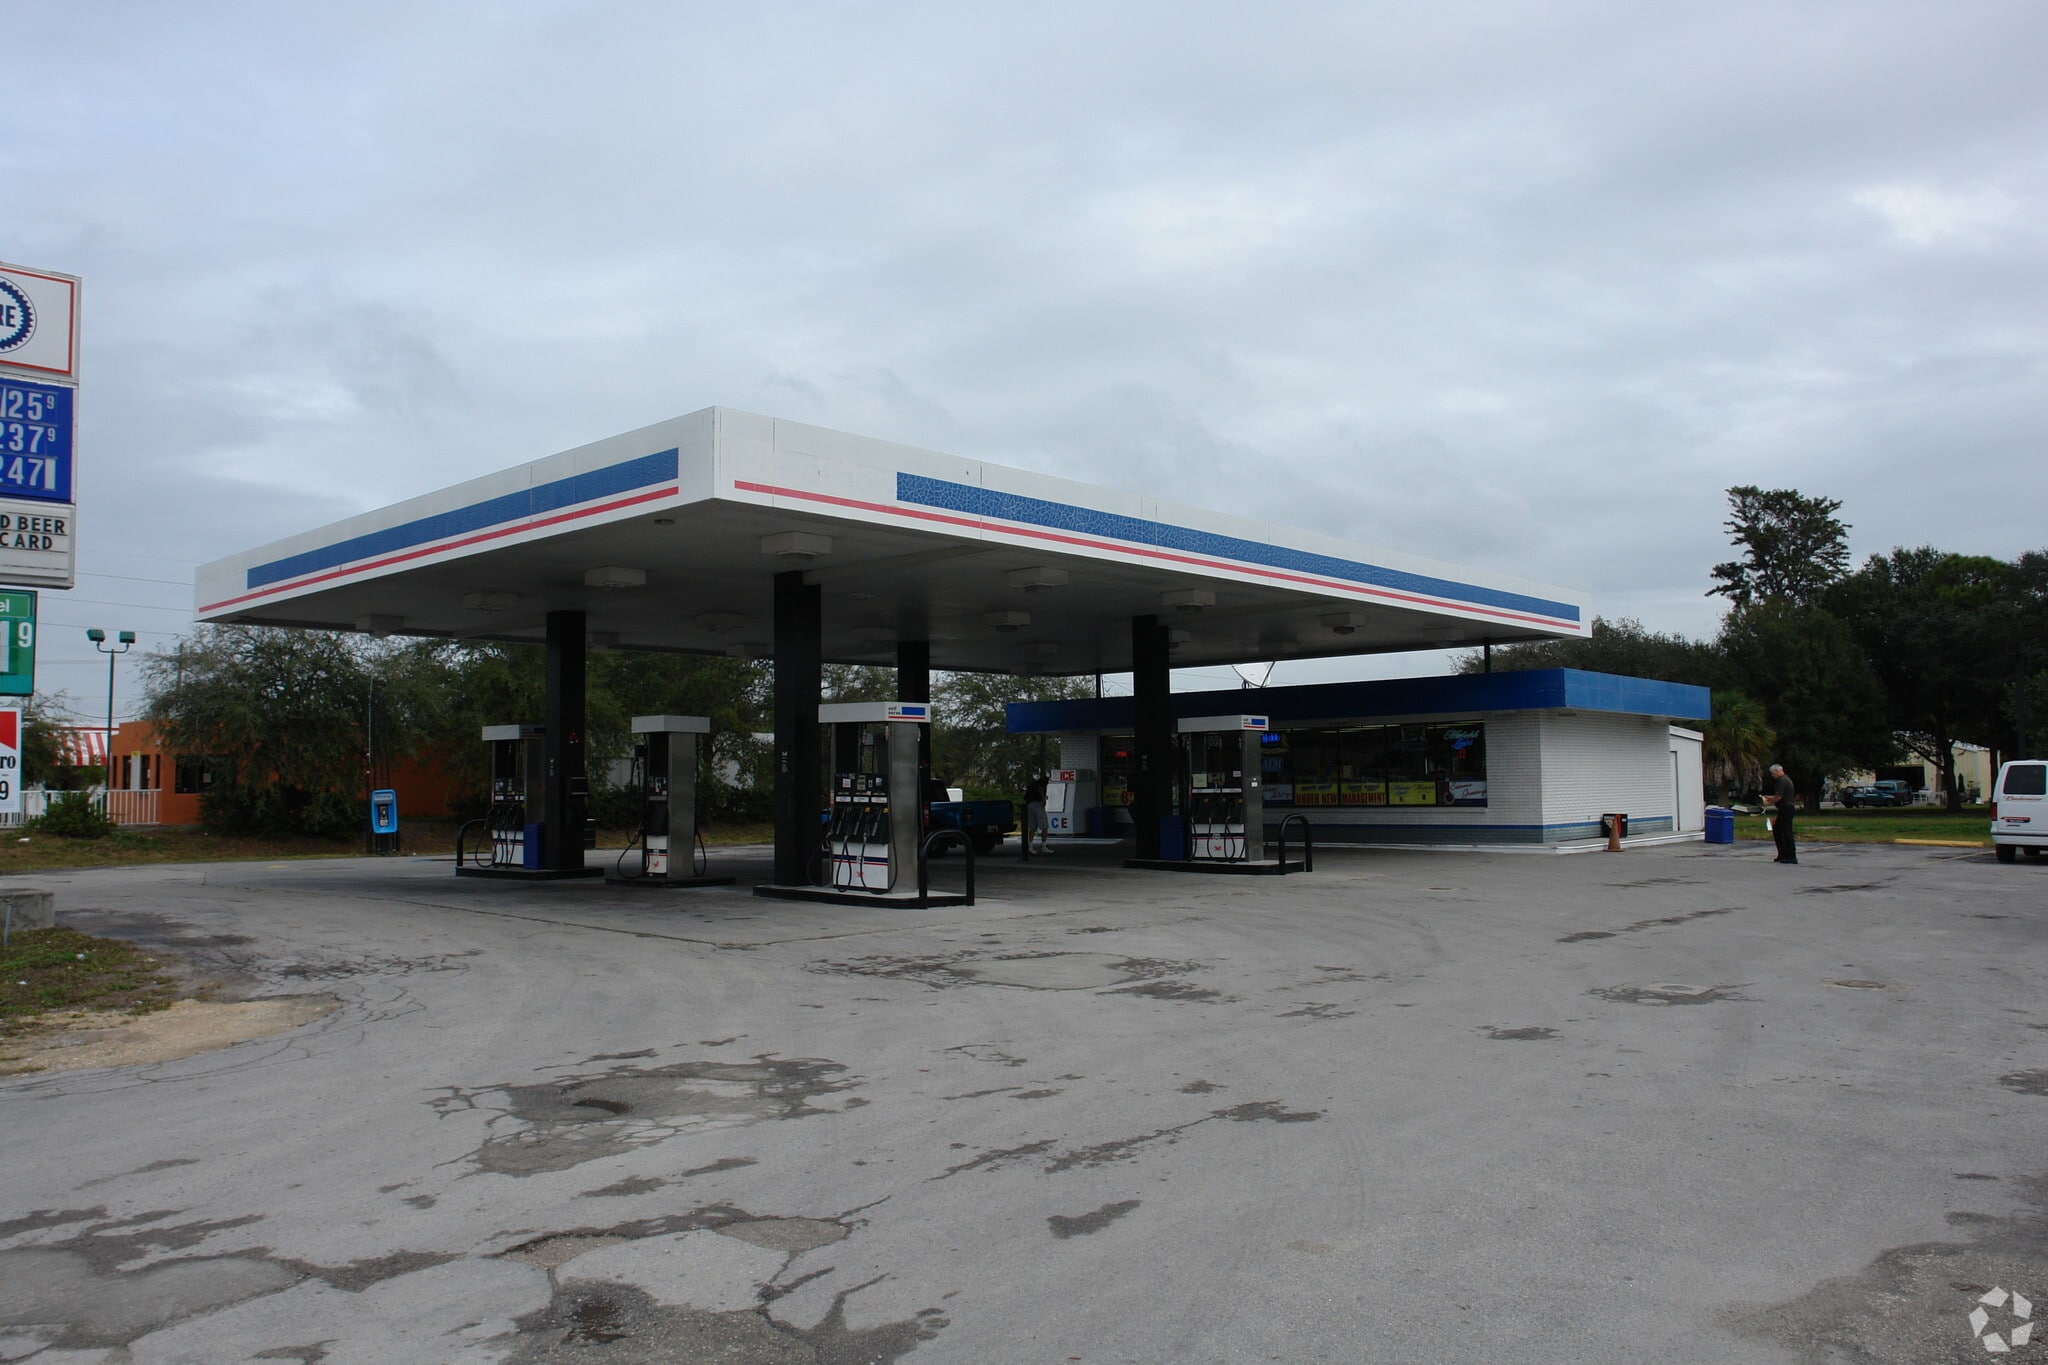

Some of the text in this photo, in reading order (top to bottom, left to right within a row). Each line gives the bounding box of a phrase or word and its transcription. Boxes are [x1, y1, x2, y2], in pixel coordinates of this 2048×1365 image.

[46, 395, 55, 409] 9
[47, 428, 56, 442] 9
[0, 455, 44, 486] 47
[17, 516, 65, 533] BEER
[0, 532, 52, 549] CARD
[18, 622, 32, 647] 9
[1060, 771, 1075, 781] ICE
